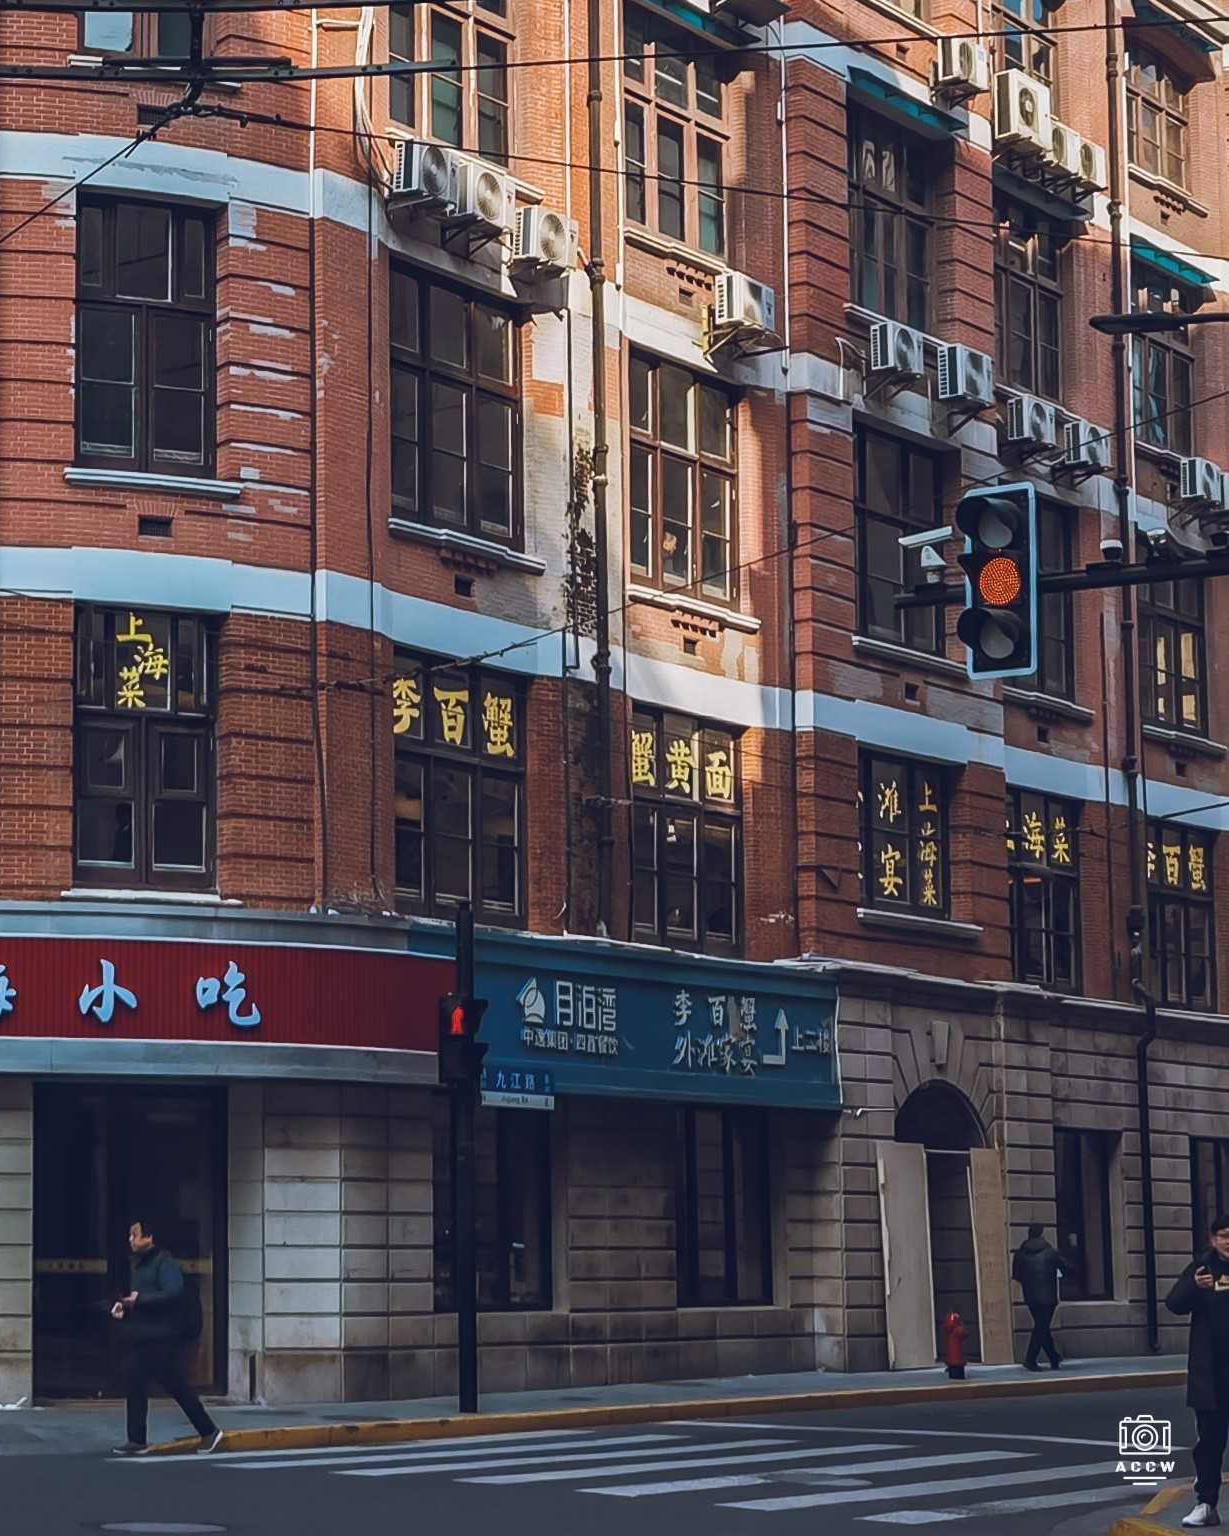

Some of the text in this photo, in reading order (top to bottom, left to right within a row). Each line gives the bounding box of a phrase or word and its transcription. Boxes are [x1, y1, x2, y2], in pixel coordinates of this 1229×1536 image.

[115, 612, 170, 710] 上海菜
[393, 677, 514, 758] 李百蟹
[631, 729, 733, 800] 蟹黄面
[674, 989, 757, 1031] 李百蟹
